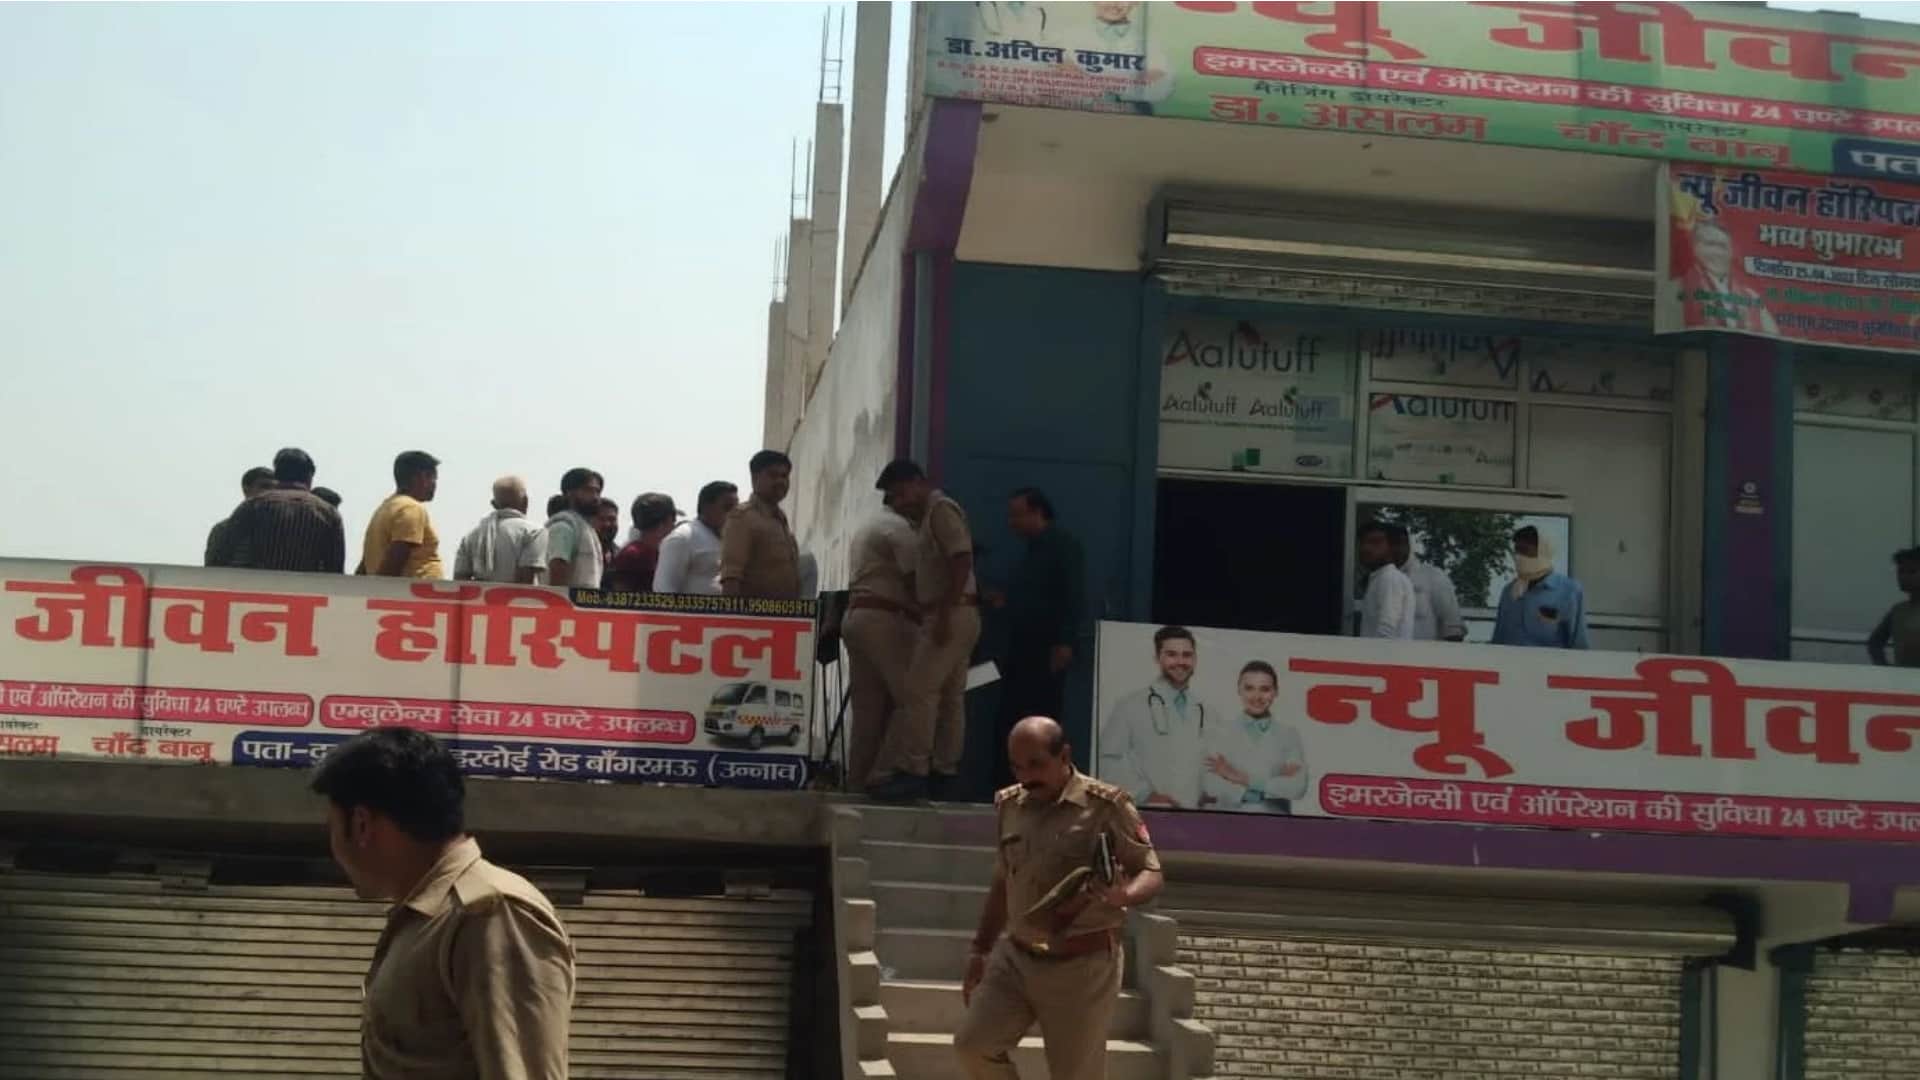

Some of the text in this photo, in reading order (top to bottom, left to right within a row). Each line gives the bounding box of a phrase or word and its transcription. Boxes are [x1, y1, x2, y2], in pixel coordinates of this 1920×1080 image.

[1074, 49, 1147, 73] कुमार
[1209, 94, 1280, 122] डा.
[1377, 66, 1430, 86] एवं
[1587, 86, 1633, 105] की
[1644, 91, 1740, 115] सुविधा
[1750, 103, 1782, 120] 24
[1722, 172, 1816, 217] जीवन
[1165, 328, 1322, 373] Aalutuff
[5, 566, 813, 681] जीवन हॉस्पिटल
[9, 684, 36, 707] एवं
[37, 685, 107, 710] ऑपरेशन
[112, 688, 136, 711] की
[193, 696, 211, 713] 24
[216, 694, 248, 716] घण्टे
[252, 699, 309, 719] उपलब्ध
[449, 704, 500, 727] सेवा
[508, 711, 533, 728] 24
[543, 708, 593, 732] घण्टे
[600, 714, 689, 736] उपलब्ध
[1289, 658, 1515, 778] न्यू
[92, 732, 149, 755] चाँद
[537, 748, 579, 773] रोड
[585, 750, 697, 778] बाँगरमऊ
[707, 753, 808, 788] (उन्नाव)
[1326, 781, 1464, 812] इमरजेन्सी
[1472, 786, 1513, 815] एवं
[1519, 790, 1637, 820] ऑपरेशन
[1645, 794, 1683, 823] की
[1690, 797, 1773, 831] सुविधा
[1779, 805, 1806, 828] 24
[1815, 803, 1865, 830] घण्टे
